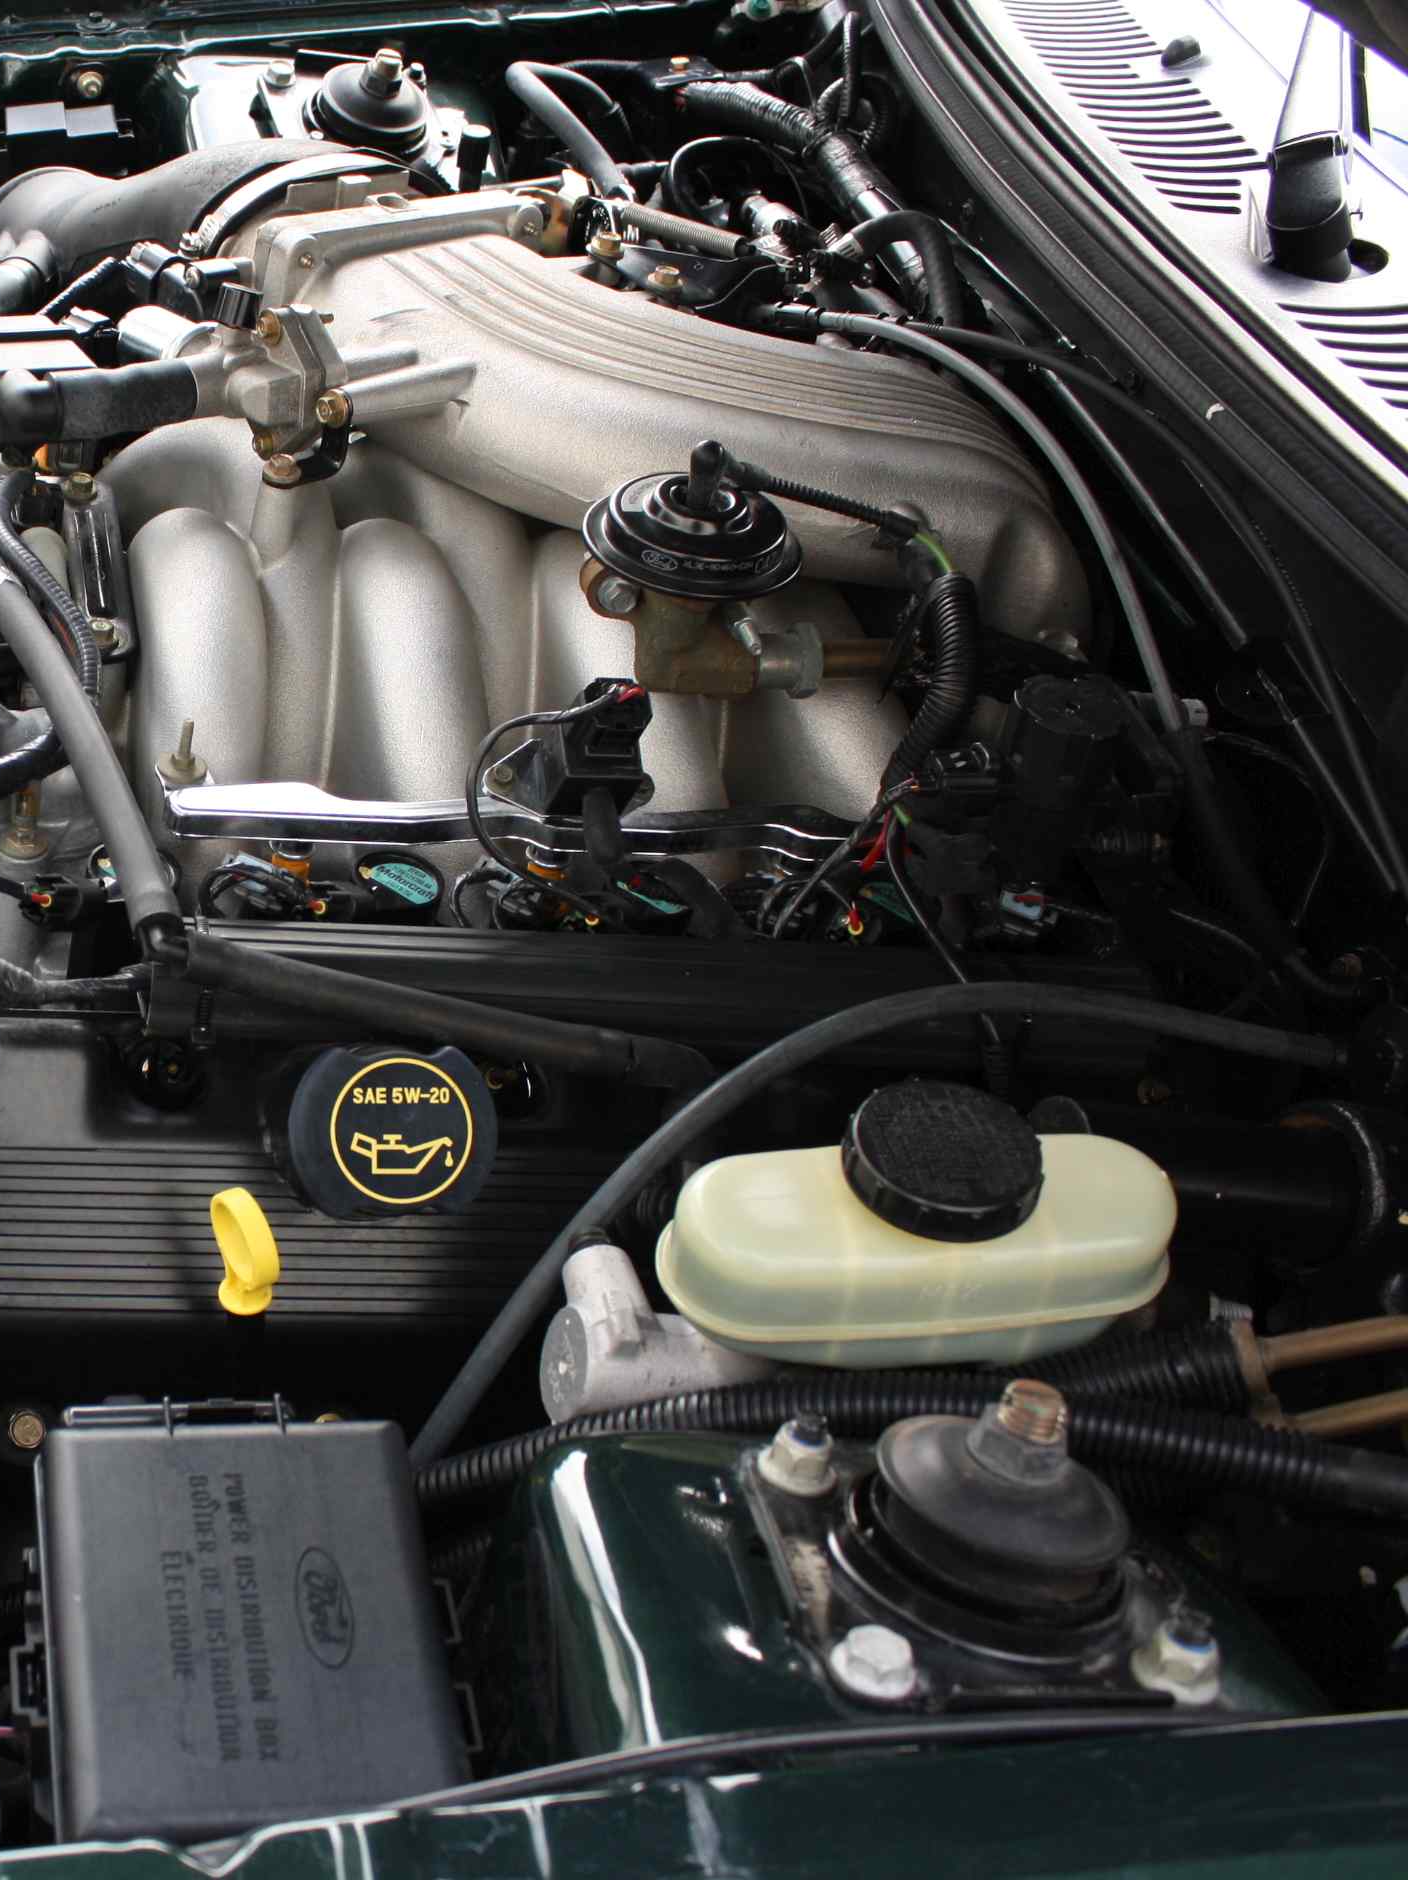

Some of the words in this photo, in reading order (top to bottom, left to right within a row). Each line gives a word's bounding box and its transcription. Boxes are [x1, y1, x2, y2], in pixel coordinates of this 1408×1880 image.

[377, 866, 434, 899] Motorcraft
[352, 1087, 387, 1105] SAE
[391, 1087, 450, 1104] 5W-20
[222, 1472, 251, 1543] POWER
[200, 1567, 223, 1596] DE
[235, 1556, 278, 1703] DISTRIBUTION
[204, 1609, 240, 1761] DISTRIBUTION
[255, 1719, 279, 1761] BOX
